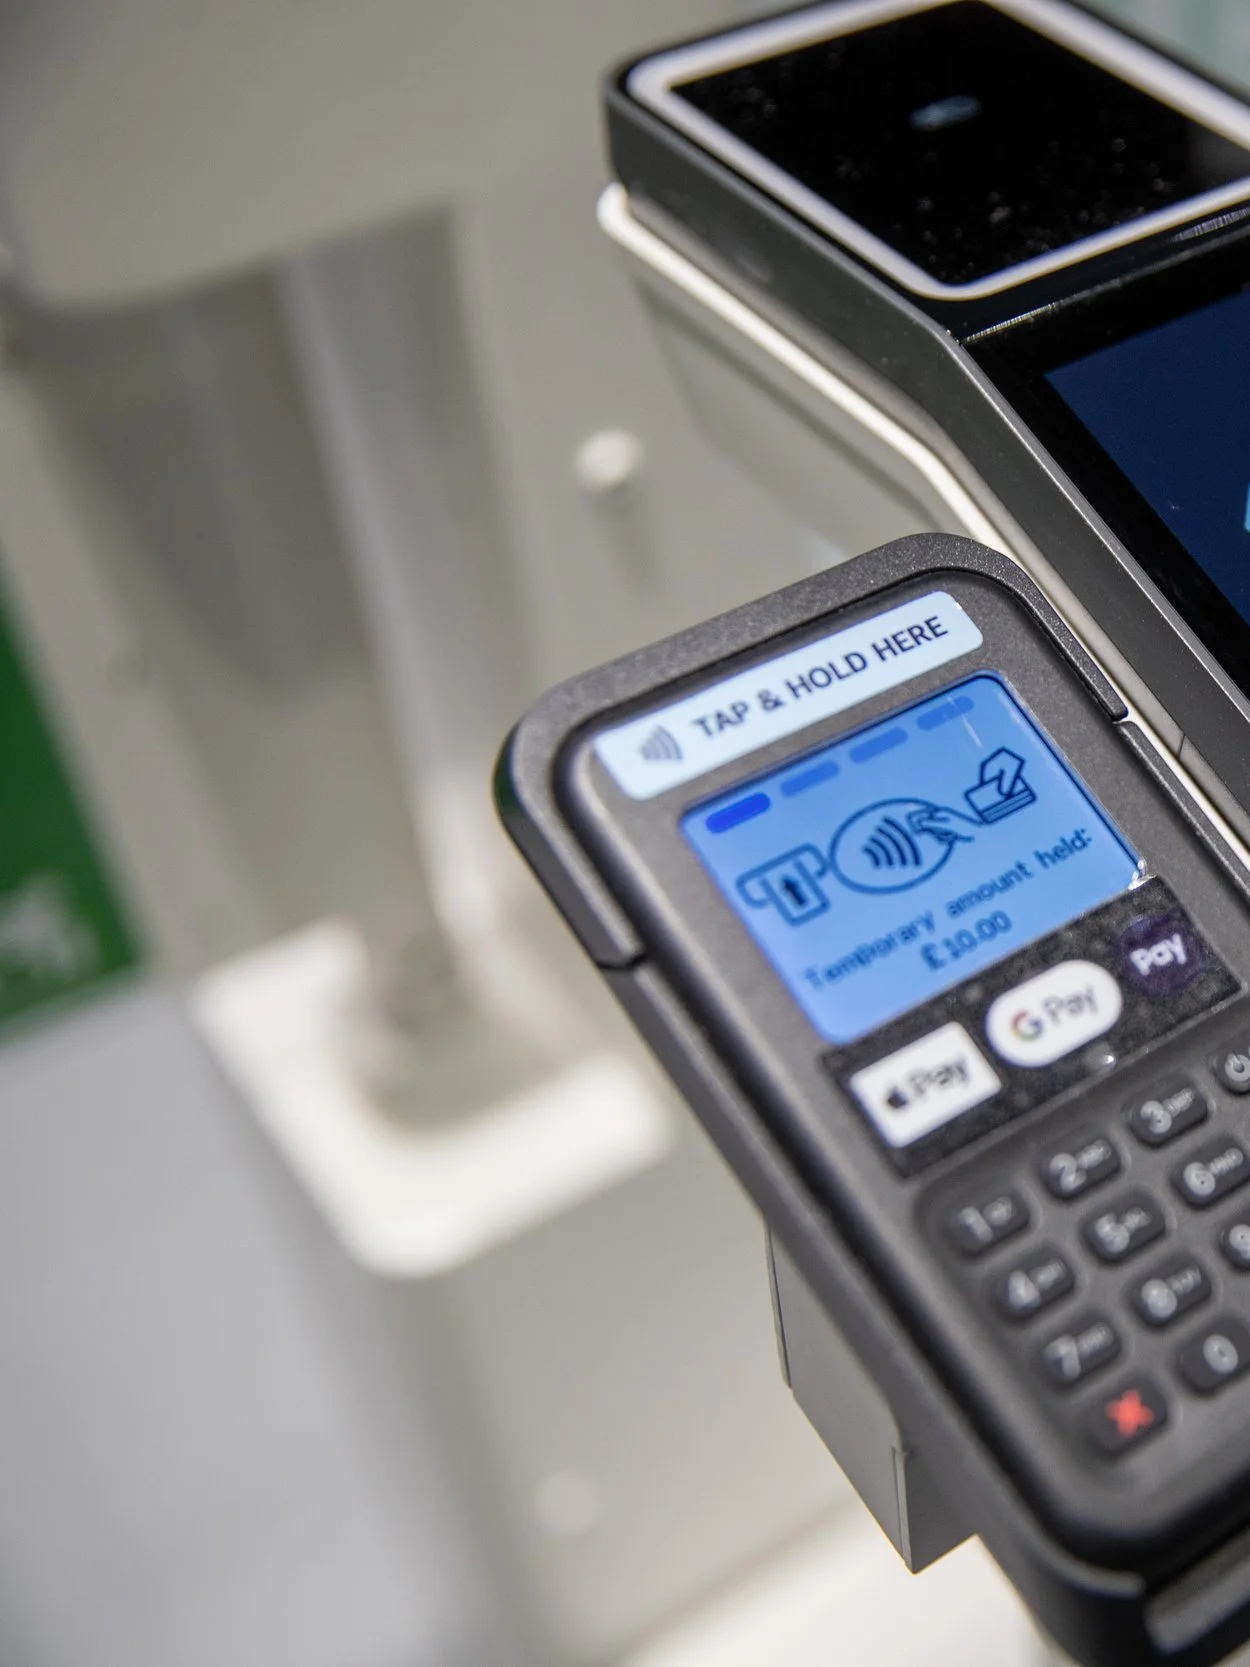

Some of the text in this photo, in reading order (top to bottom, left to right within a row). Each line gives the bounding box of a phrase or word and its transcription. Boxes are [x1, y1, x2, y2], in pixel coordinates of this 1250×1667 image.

[692, 614, 950, 739] TAP & HOLD HERE
[803, 828, 1093, 990] Temporary amount held:
[920, 911, 1012, 972] £10.00
[1012, 984, 1099, 1041] G Pay
[907, 1052, 971, 1097] Pay
